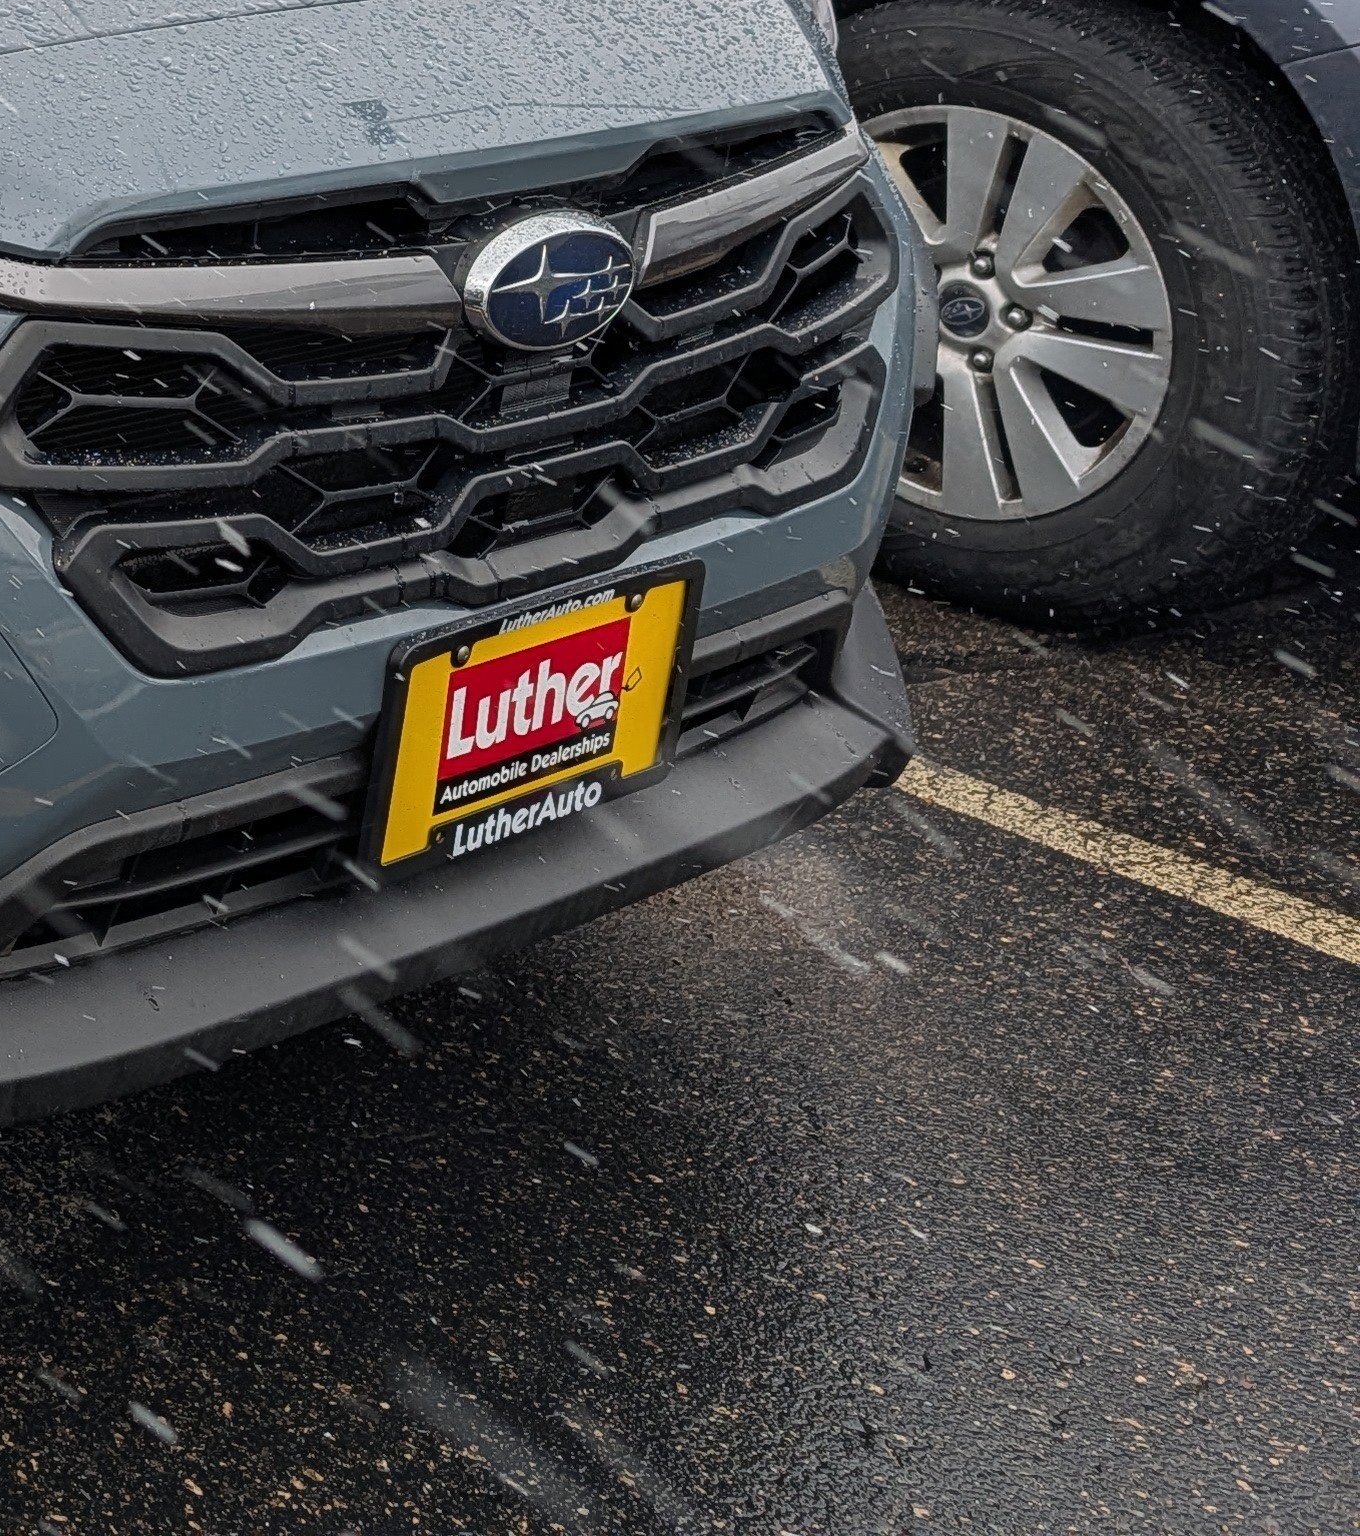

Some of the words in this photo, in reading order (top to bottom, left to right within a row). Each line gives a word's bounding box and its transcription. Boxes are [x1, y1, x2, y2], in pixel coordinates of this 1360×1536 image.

[498, 589, 615, 635] LutherAuto.com
[446, 651, 624, 760] Luther
[440, 761, 527, 805] Automobile
[530, 731, 611, 774] Dealerships
[452, 781, 602, 857] LutherAuto
